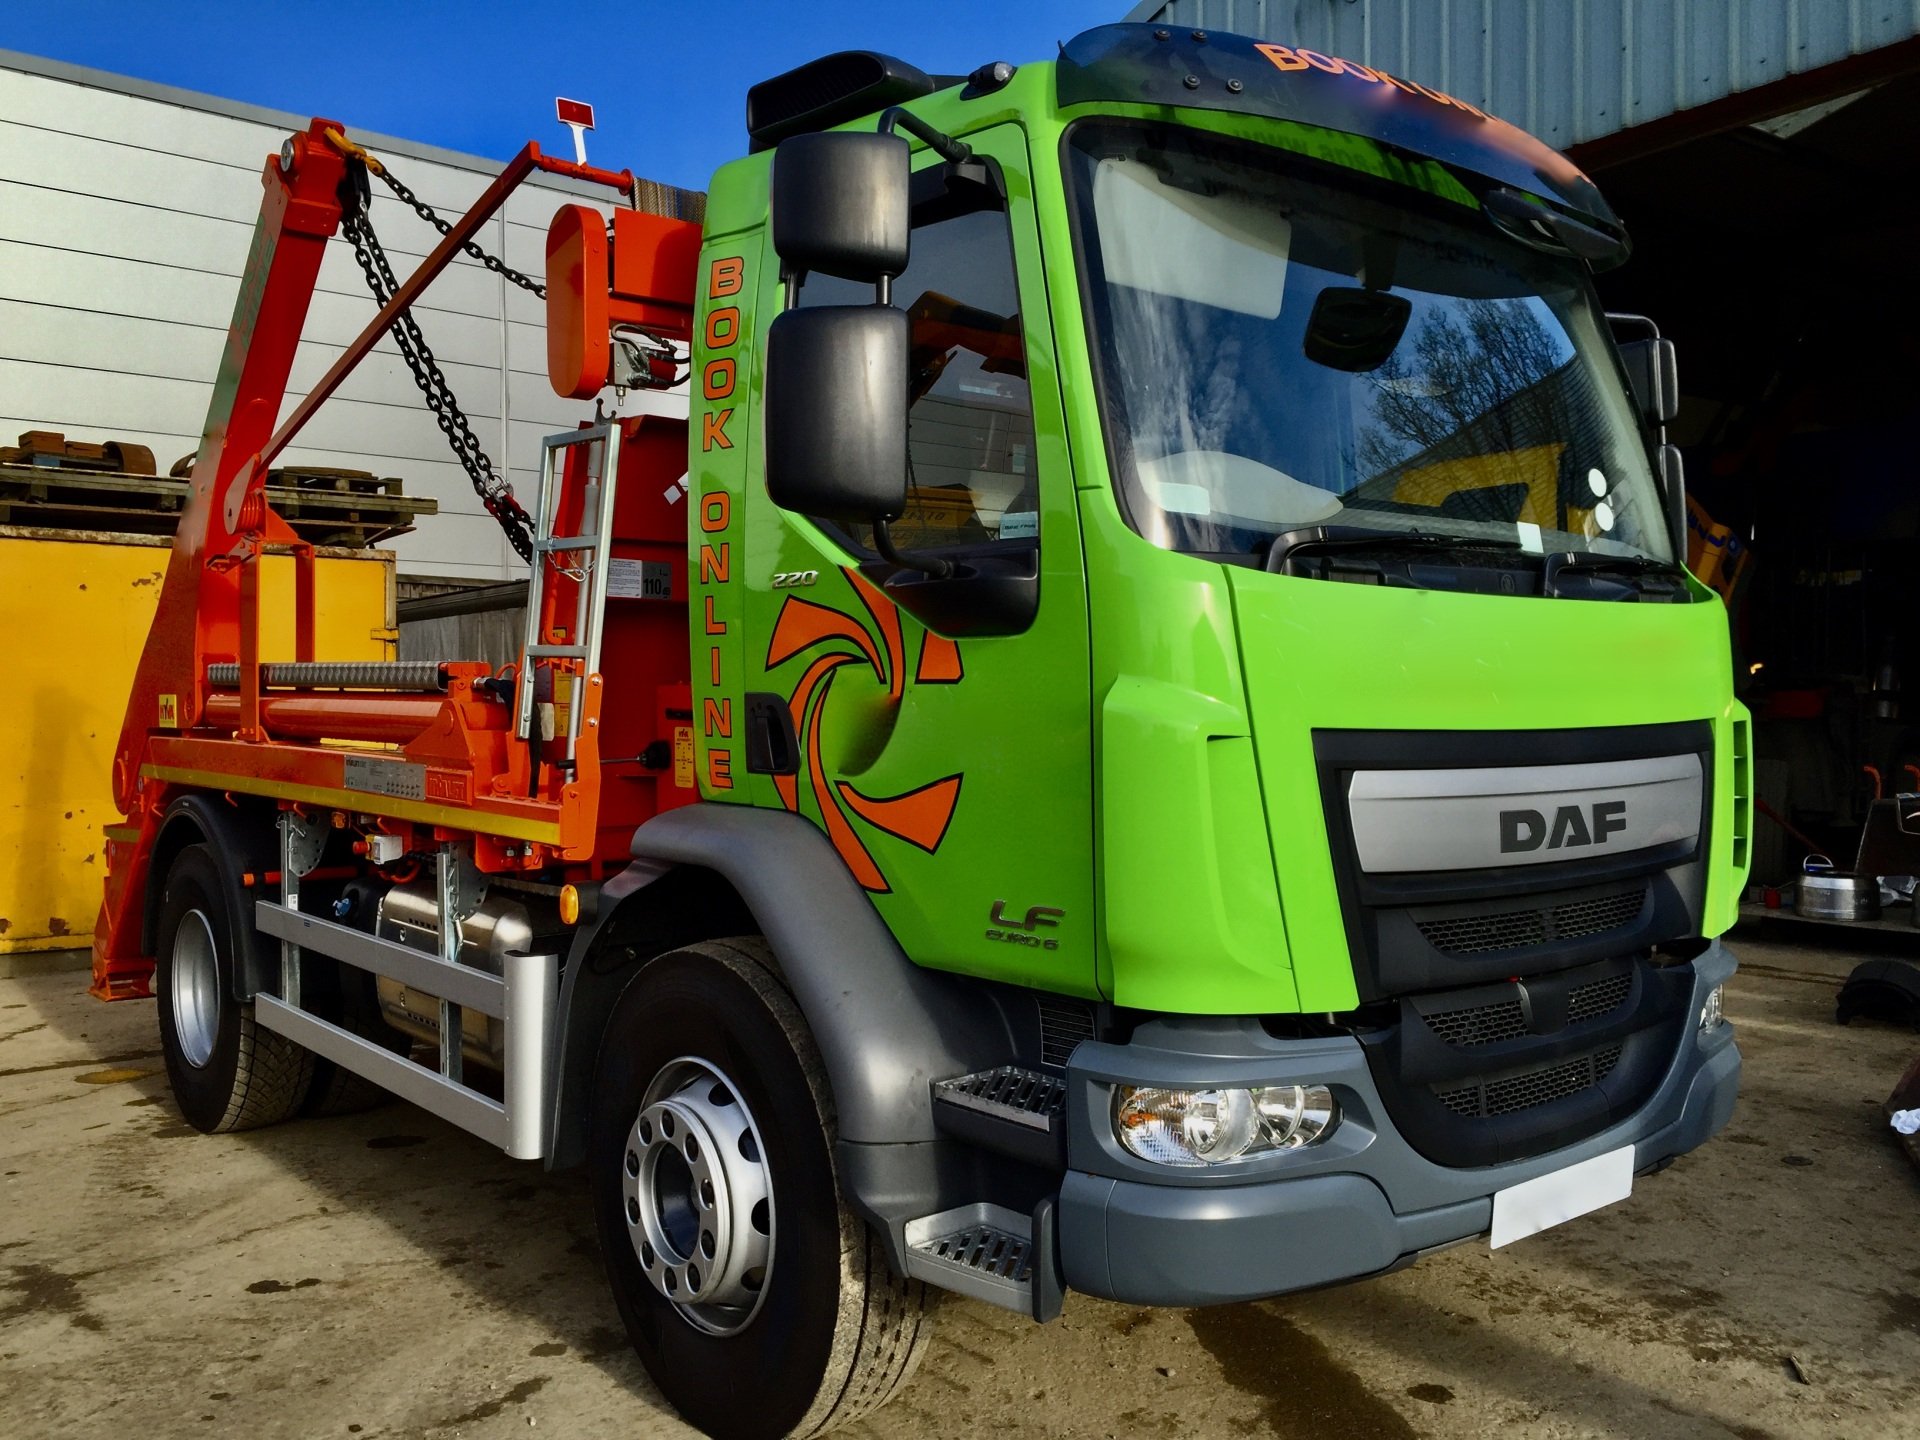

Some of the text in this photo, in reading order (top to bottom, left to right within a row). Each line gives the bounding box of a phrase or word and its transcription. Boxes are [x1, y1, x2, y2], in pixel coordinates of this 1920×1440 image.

[701, 256, 745, 789] BOOK ONLINE
[772, 570, 818, 589] 220
[1500, 801, 1626, 853] DAF
[990, 899, 1065, 931] LF
